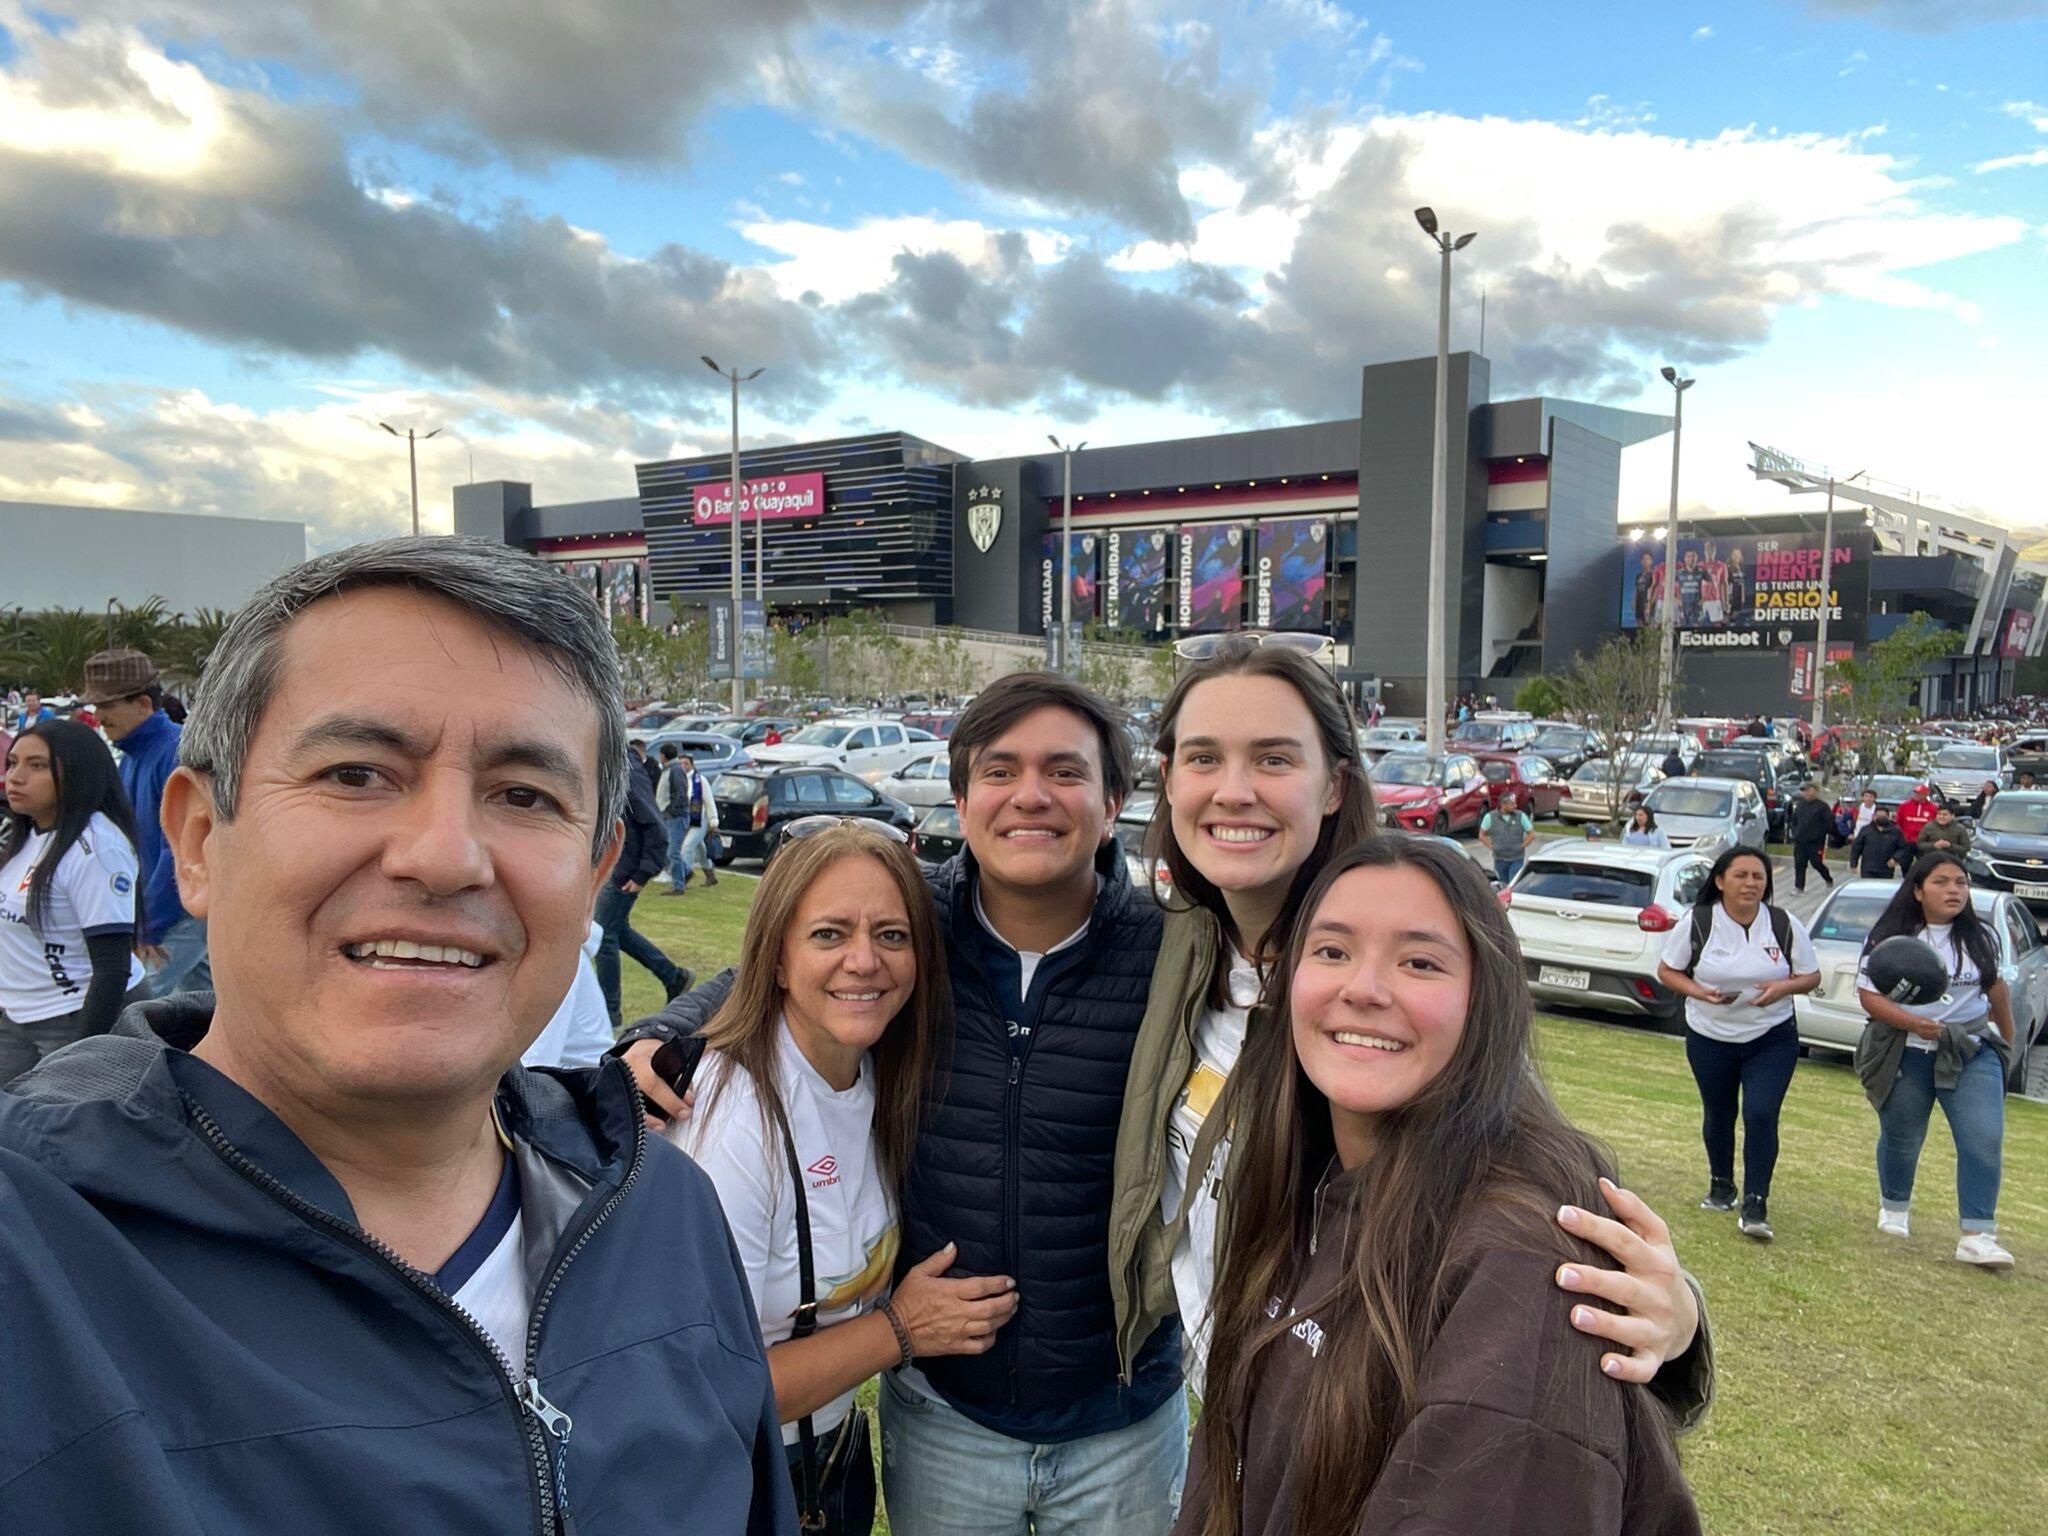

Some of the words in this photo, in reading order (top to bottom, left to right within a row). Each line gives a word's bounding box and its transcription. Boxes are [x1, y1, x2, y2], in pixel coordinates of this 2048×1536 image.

[1756, 541, 1779, 552] SER
[1107, 532, 1120, 629] SOIDARIDAD
[1179, 534, 1193, 628] HONESTIDAD
[1755, 564, 1832, 581] DIENT
[1258, 557, 1272, 627] RESPETO
[1755, 581, 1769, 591] ES
[1771, 580, 1804, 591] TENER
[1806, 579, 1831, 591] UN
[1754, 606, 1843, 622] DIFERENTE
